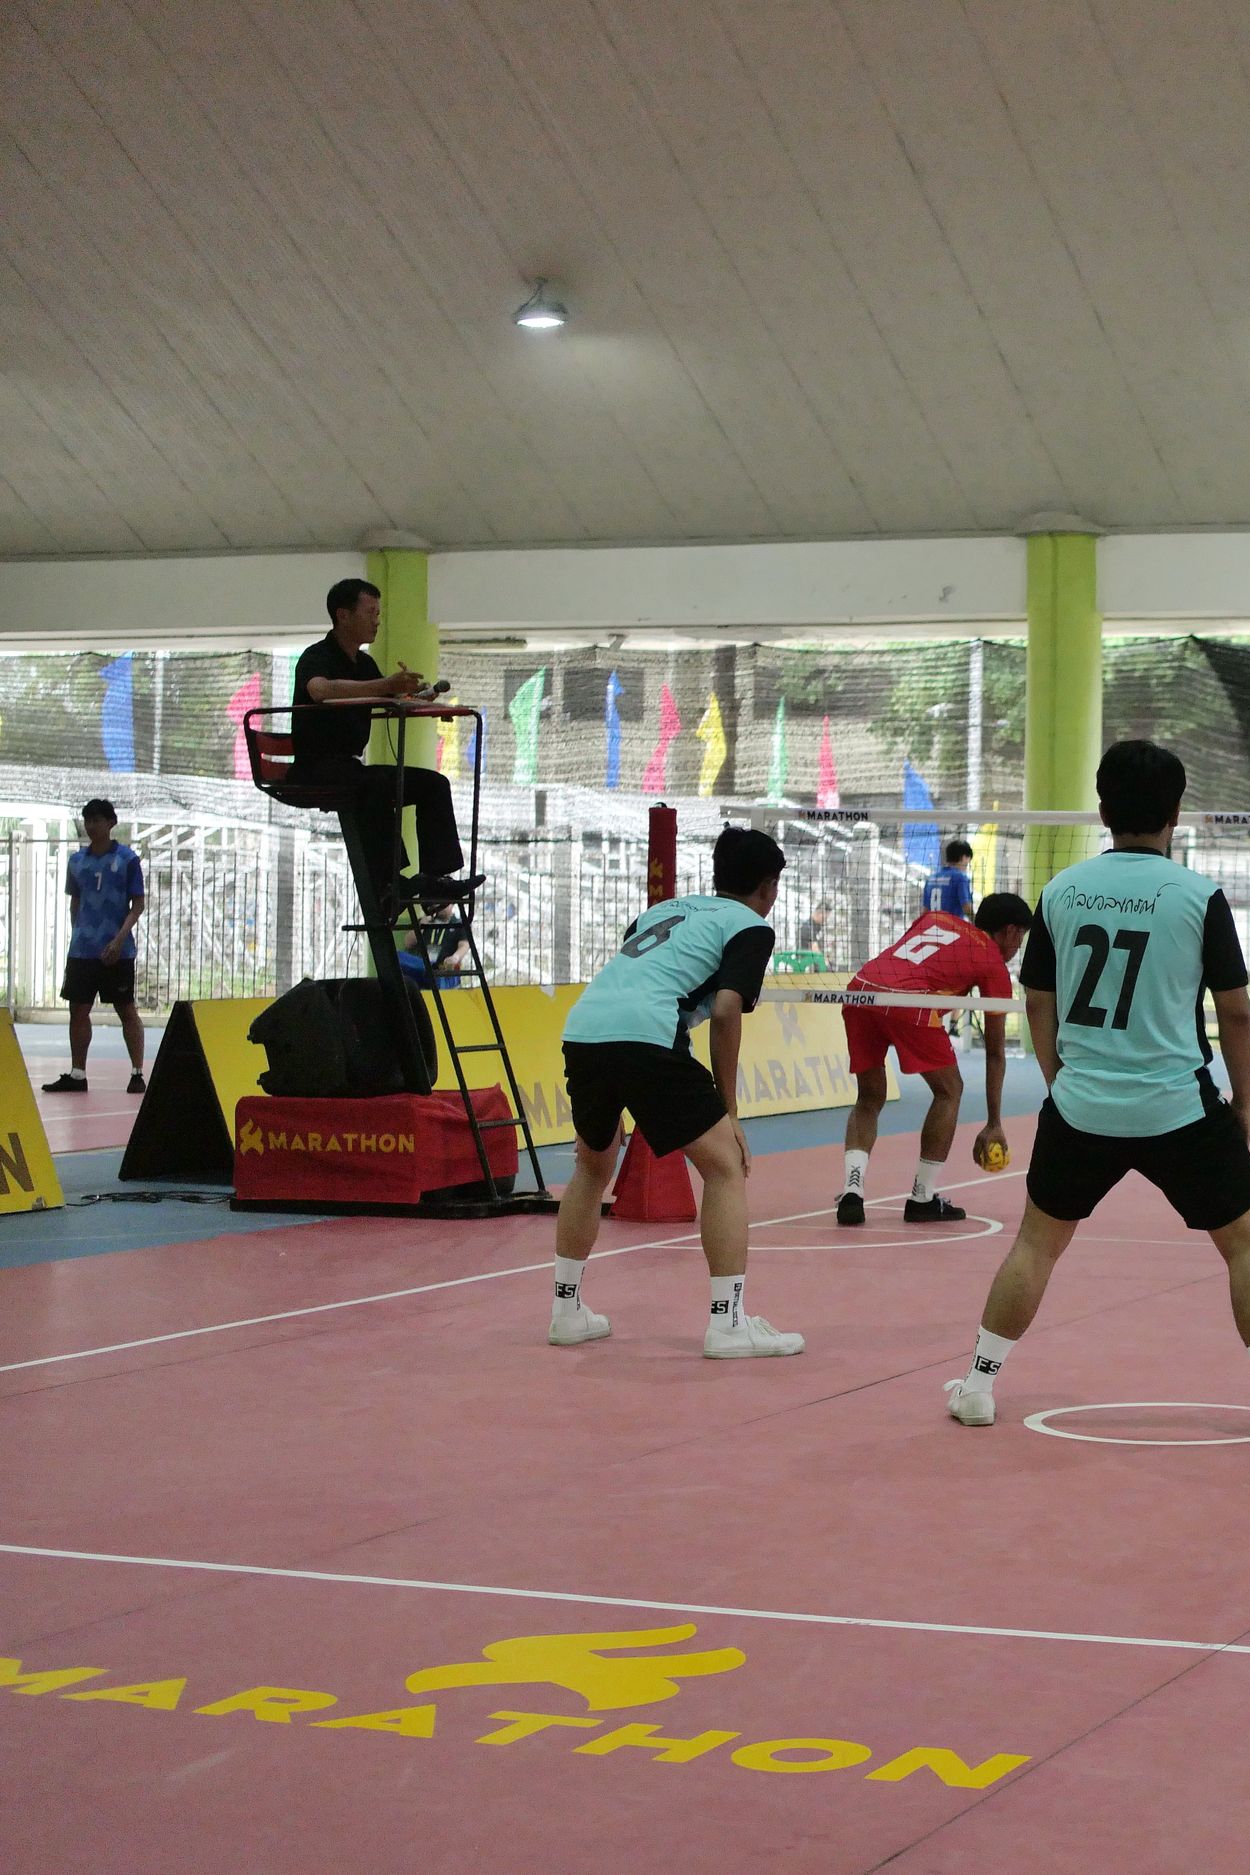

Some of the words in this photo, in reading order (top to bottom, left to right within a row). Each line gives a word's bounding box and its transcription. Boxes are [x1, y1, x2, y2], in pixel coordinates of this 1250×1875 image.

[807, 811, 869, 822] MARATHON
[620, 915, 686, 959] 6
[1065, 924, 1151, 1031] 27
[814, 993, 875, 1005] MARATHON
[268, 1132, 414, 1154] MARATHON
[556, 1283, 575, 1298] FS
[977, 1356, 1001, 1375] FS
[0, 1657, 1033, 1789] MARATHON
